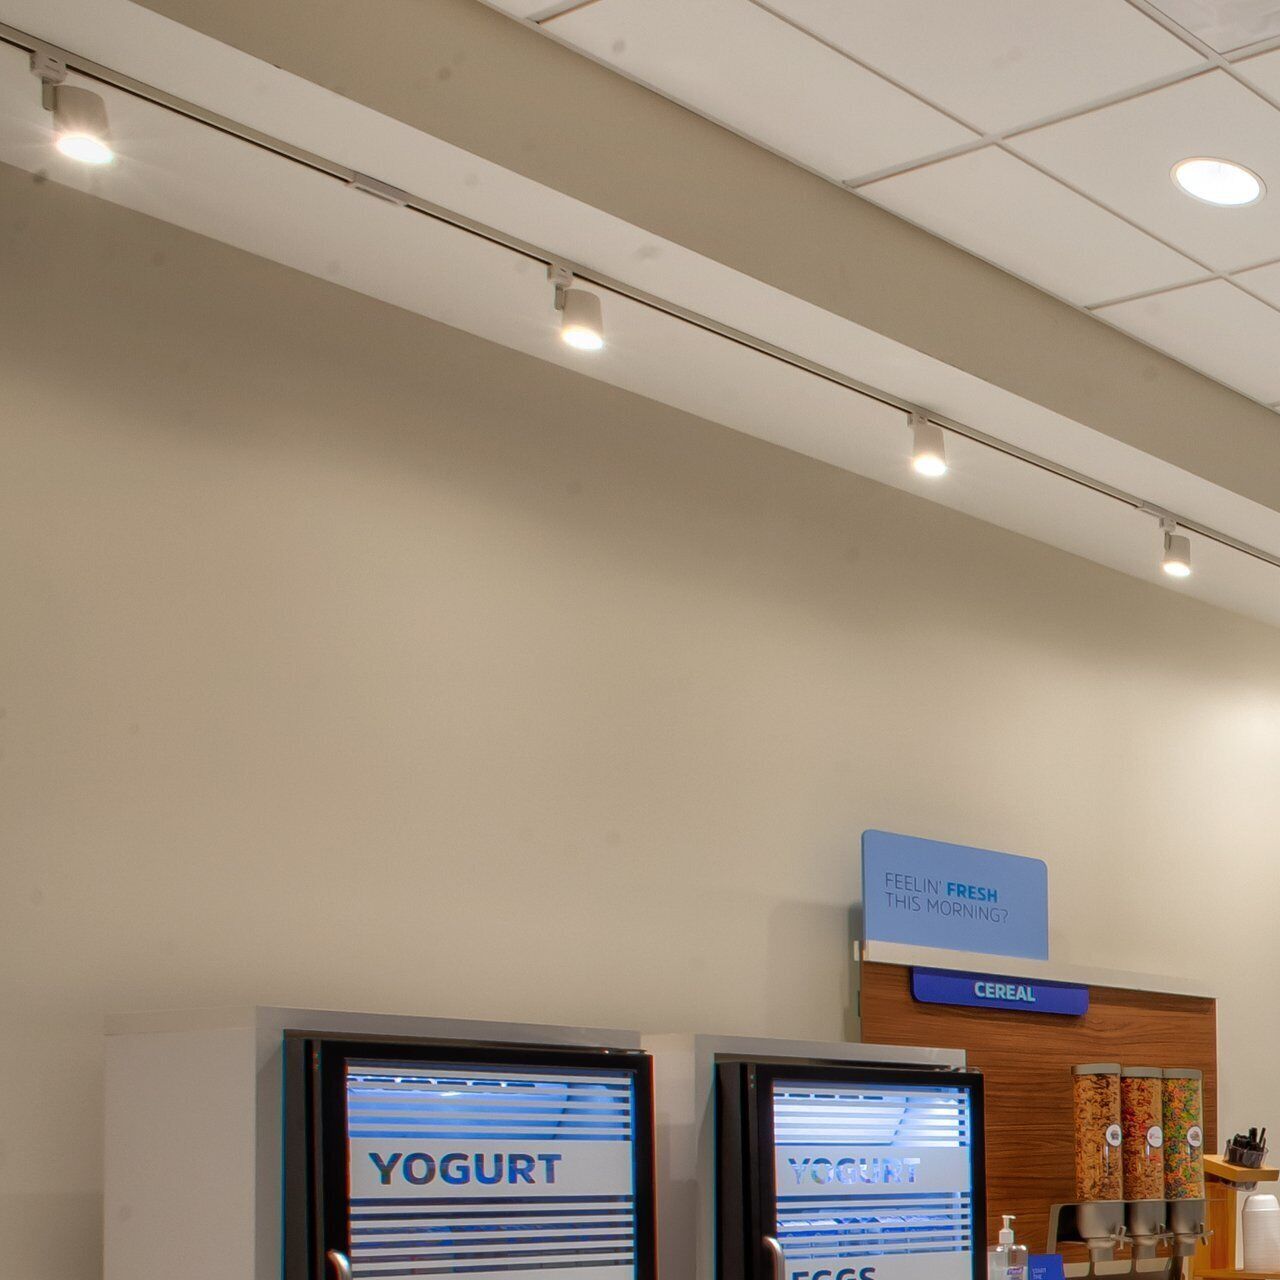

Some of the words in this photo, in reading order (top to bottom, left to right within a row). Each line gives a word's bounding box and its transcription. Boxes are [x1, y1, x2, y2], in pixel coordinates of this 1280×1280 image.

[885, 872, 942, 895] FEELIN'
[947, 881, 998, 903] FRESH
[885, 892, 921, 912] THIS
[927, 899, 1009, 923] MORNING?
[975, 981, 1036, 1002] CEREAL
[369, 1152, 562, 1186] YOGURT
[787, 1156, 921, 1186] YOGURT
